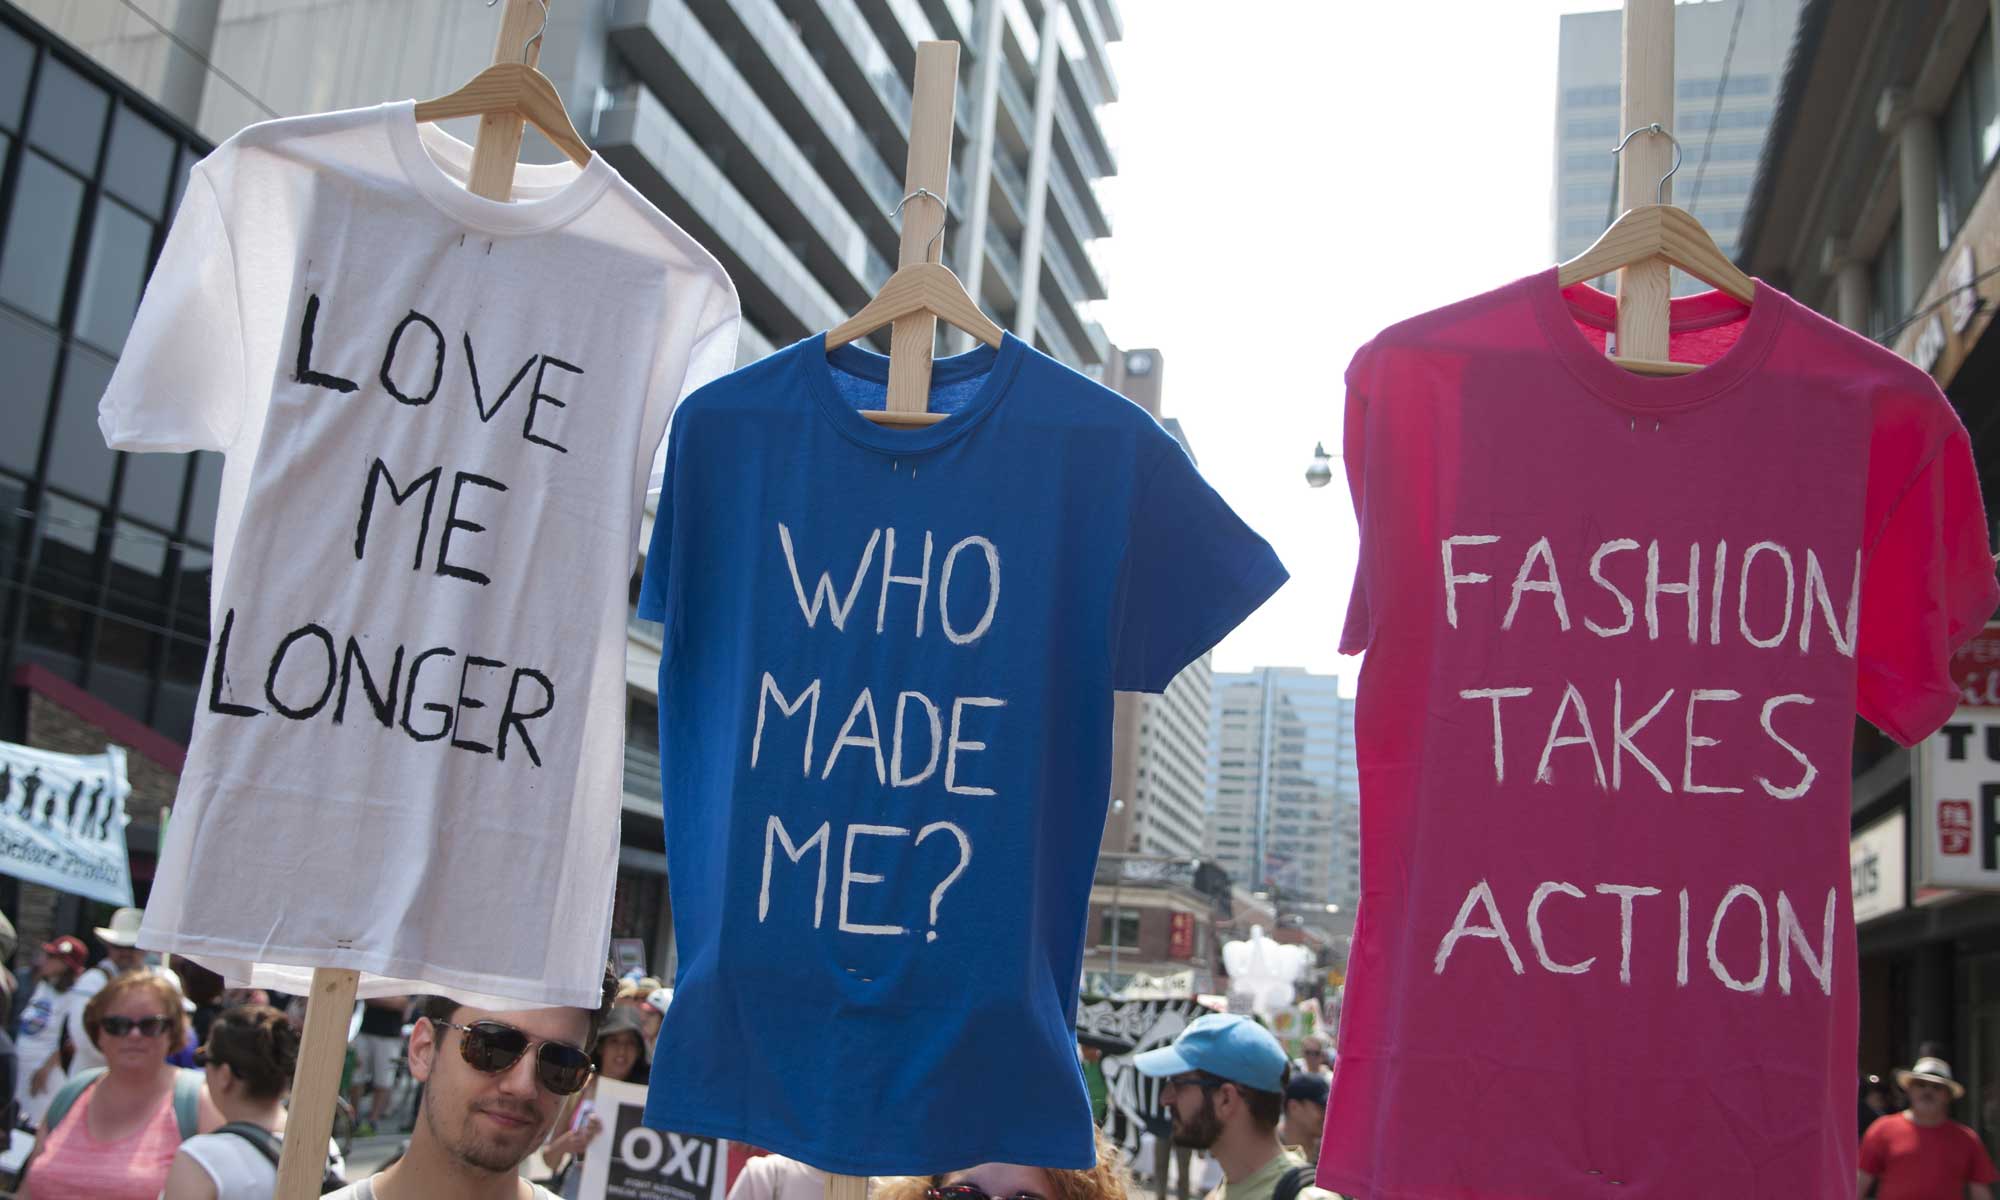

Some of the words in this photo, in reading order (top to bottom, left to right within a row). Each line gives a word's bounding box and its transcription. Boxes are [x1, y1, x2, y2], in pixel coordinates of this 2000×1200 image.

[294, 294, 584, 454] LOVE
[355, 457, 509, 587] ME
[778, 522, 1001, 645] WHO
[1441, 534, 1861, 658] FASHION
[209, 608, 555, 767] LONGER
[750, 671, 1008, 796] MADE
[1459, 677, 1818, 800] TAKES
[759, 815, 972, 943] ME?
[1434, 878, 1836, 997] ACTION
[621, 1126, 712, 1188] OXI
